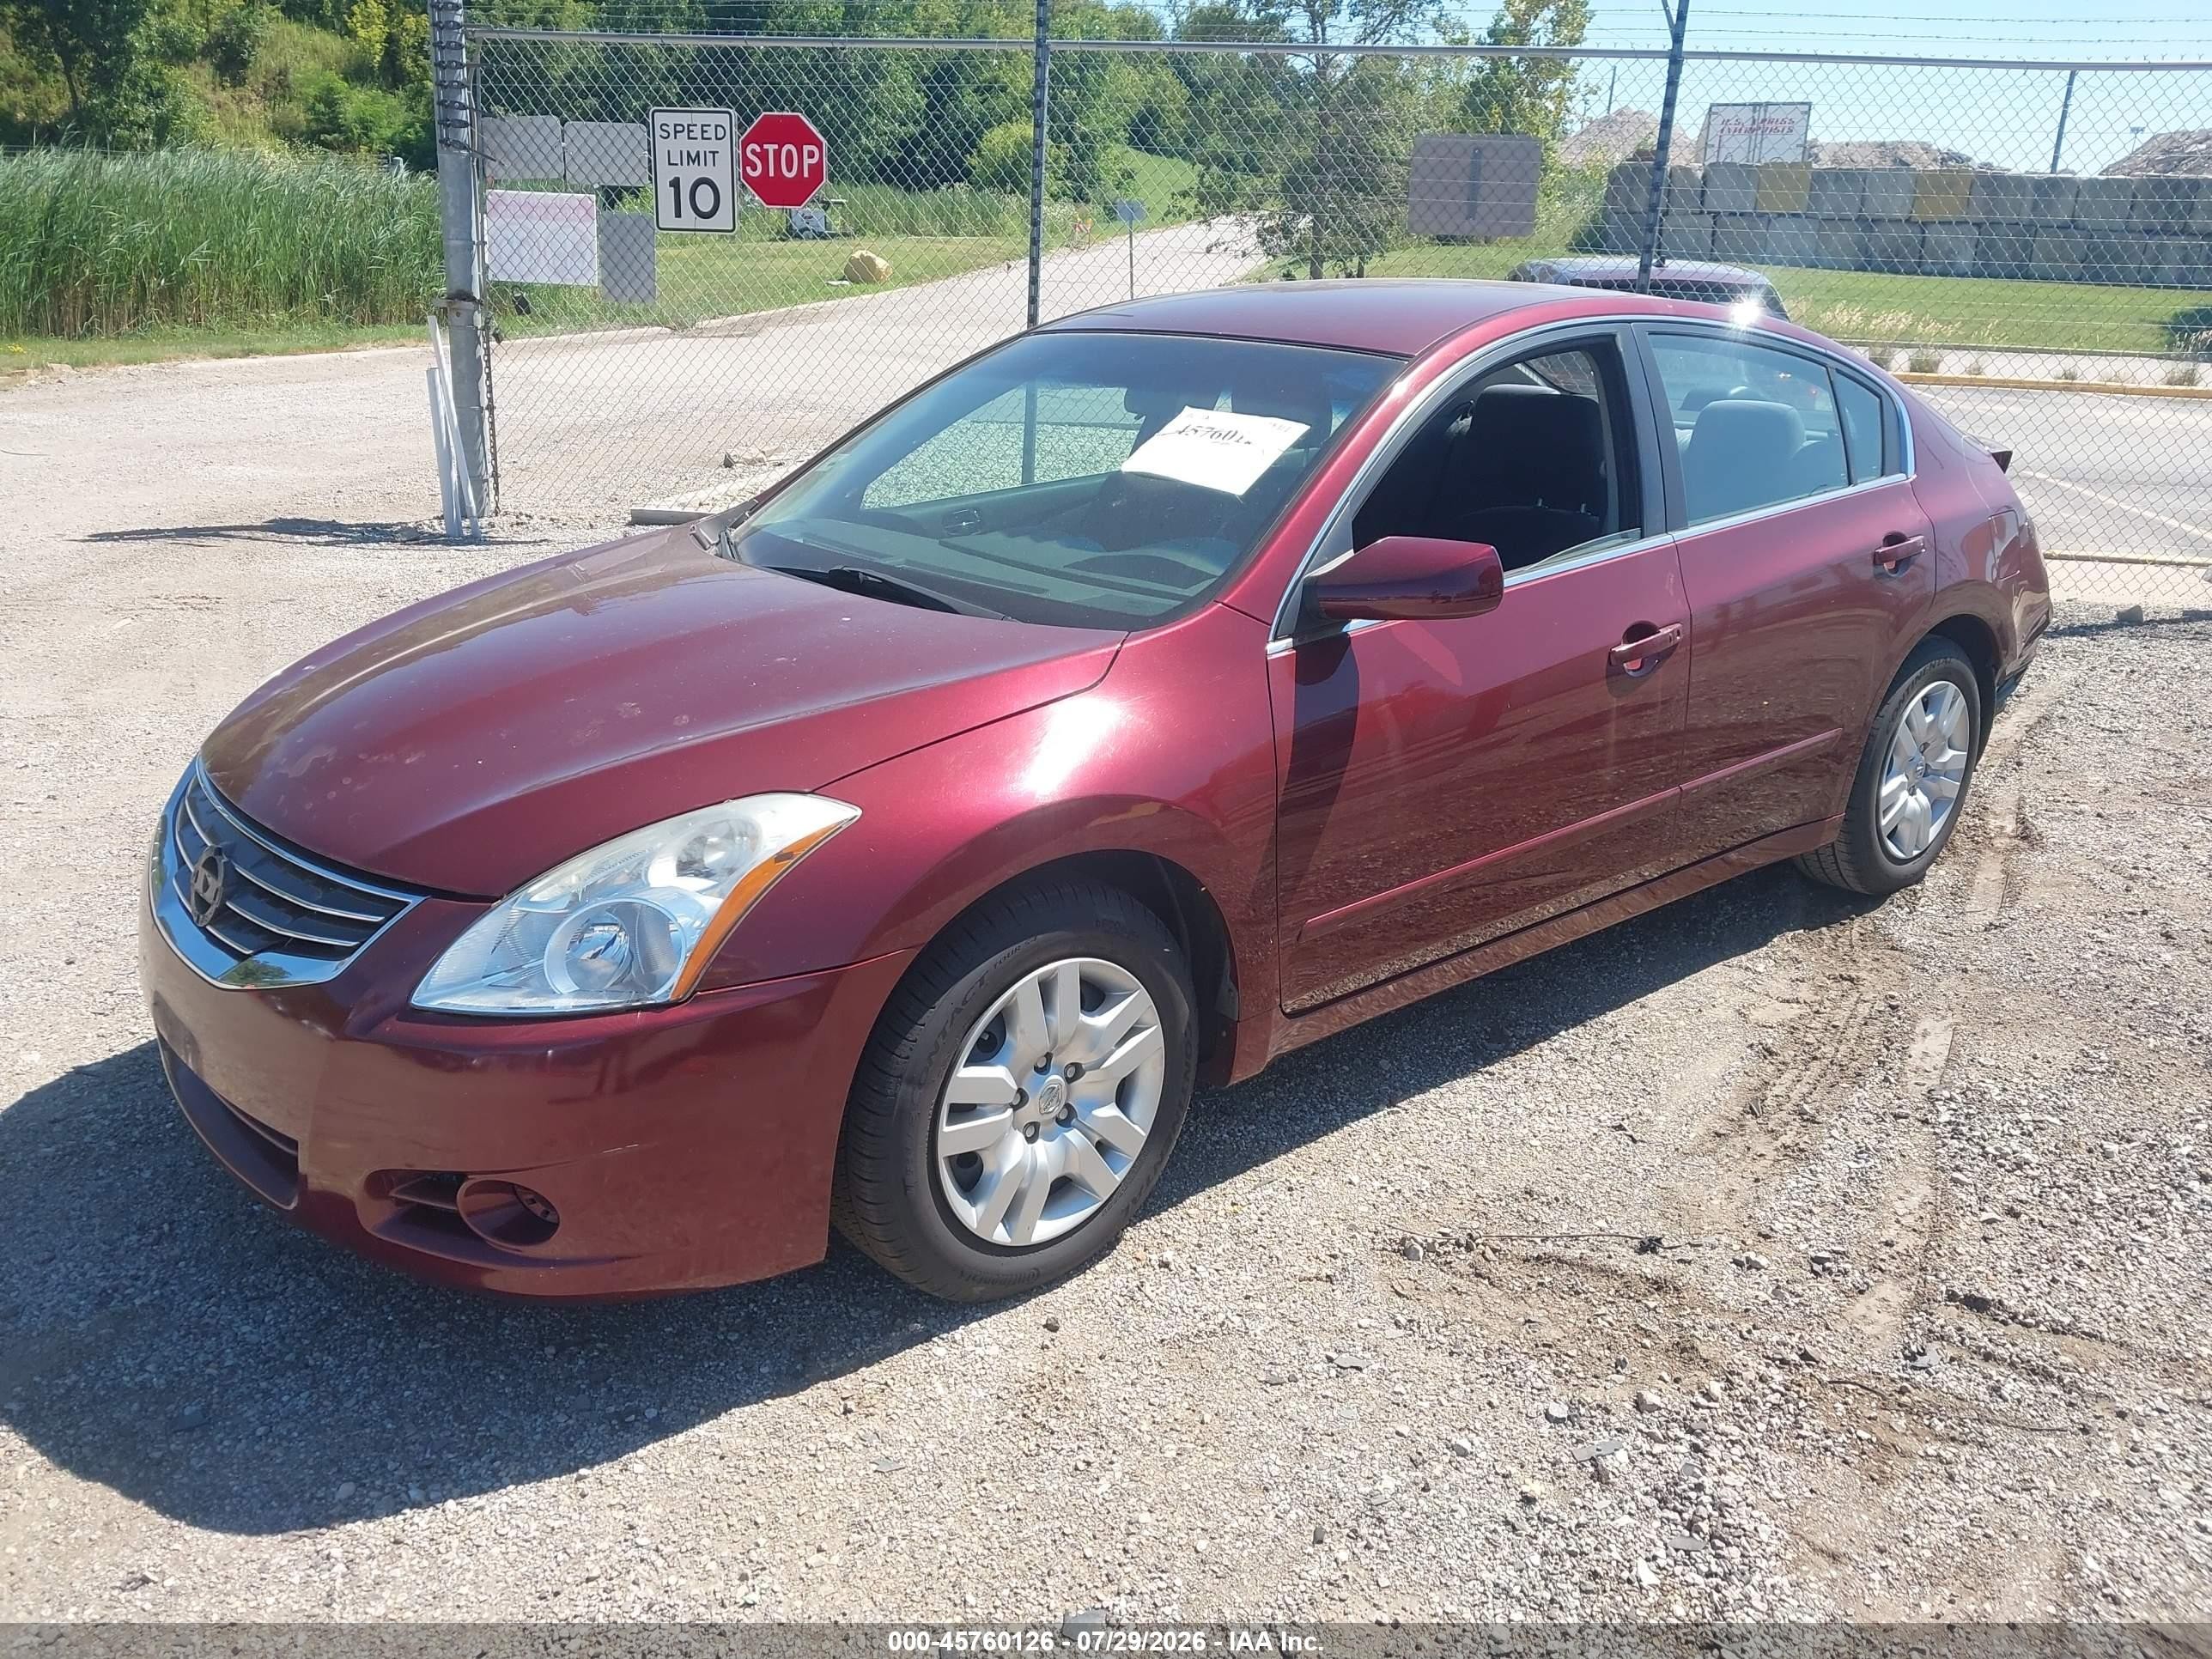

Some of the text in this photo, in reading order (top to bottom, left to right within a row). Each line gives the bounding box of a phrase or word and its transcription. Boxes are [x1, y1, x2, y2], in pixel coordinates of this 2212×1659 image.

[659, 123, 727, 141] SPEED
[666, 149, 720, 167] LIMIT
[744, 143, 820, 178] STOP
[667, 175, 720, 220] 10
